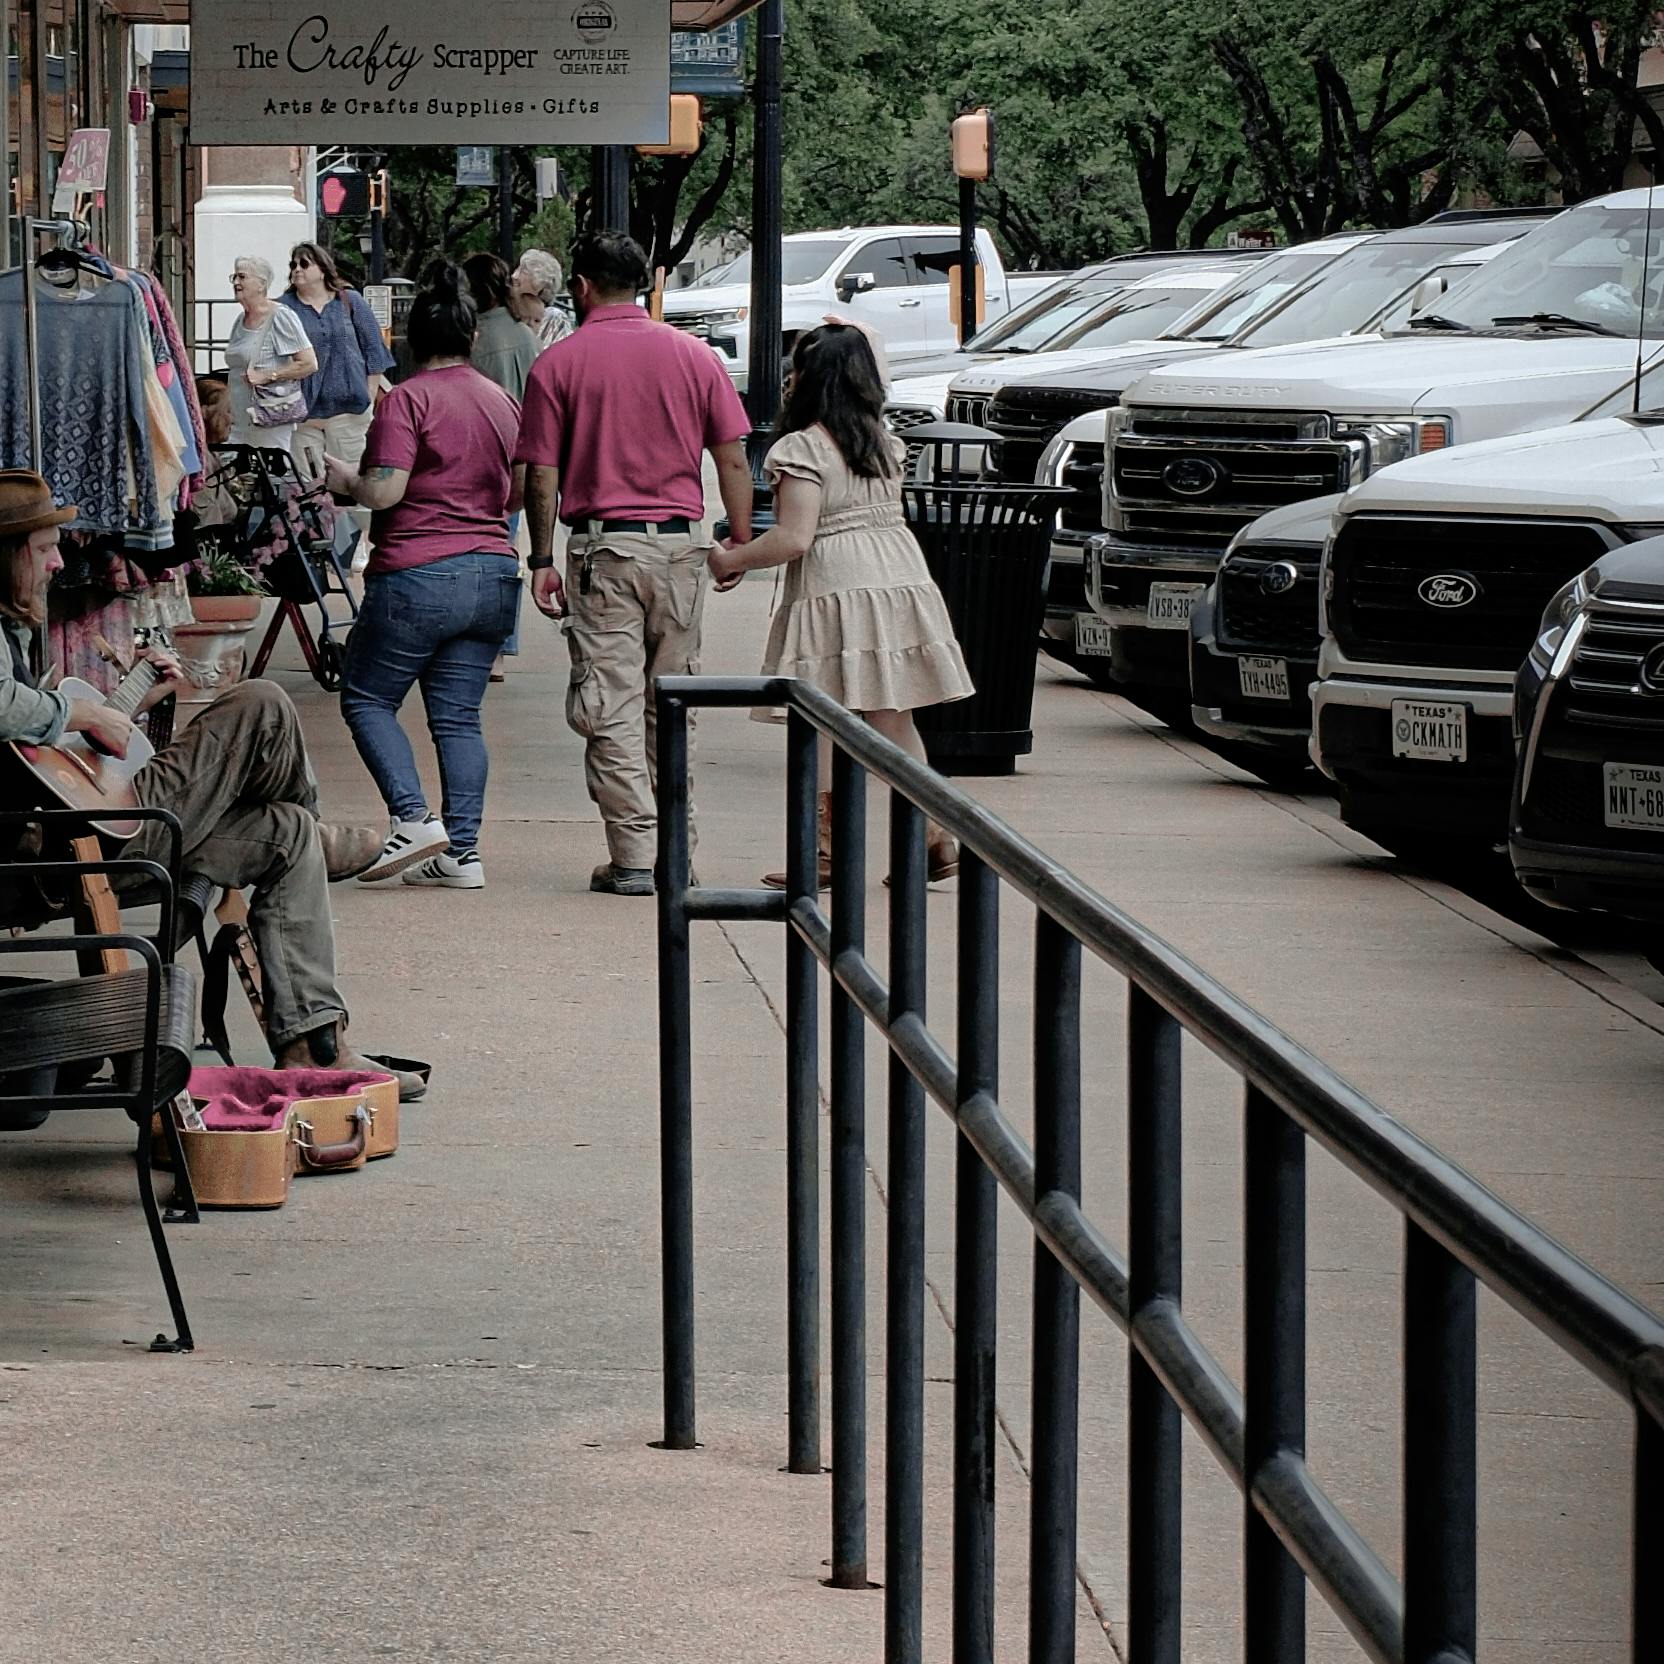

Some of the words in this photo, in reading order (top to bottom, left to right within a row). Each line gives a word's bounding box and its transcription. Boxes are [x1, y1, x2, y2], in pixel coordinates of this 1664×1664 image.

[233, 42, 279, 70] The
[287, 14, 424, 91] Crafty
[433, 44, 538, 75] Scrapper
[553, 49, 605, 61] CAPTURE
[559, 64, 603, 75] CREATE
[605, 64, 631, 75] ART.
[263, 97, 313, 116] Arts
[319, 97, 338, 116] &
[344, 97, 419, 116] Crafts
[427, 97, 524, 119] Supplies
[542, 97, 600, 116] Gifts
[1148, 383, 1217, 398] SUPER
[1225, 385, 1292, 400] DUTY
[1428, 578, 1465, 603] Ford
[1412, 705, 1446, 719] TEXAS
[1412, 721, 1462, 749] CKMATH
[1629, 768, 1662, 784] TEXAS
